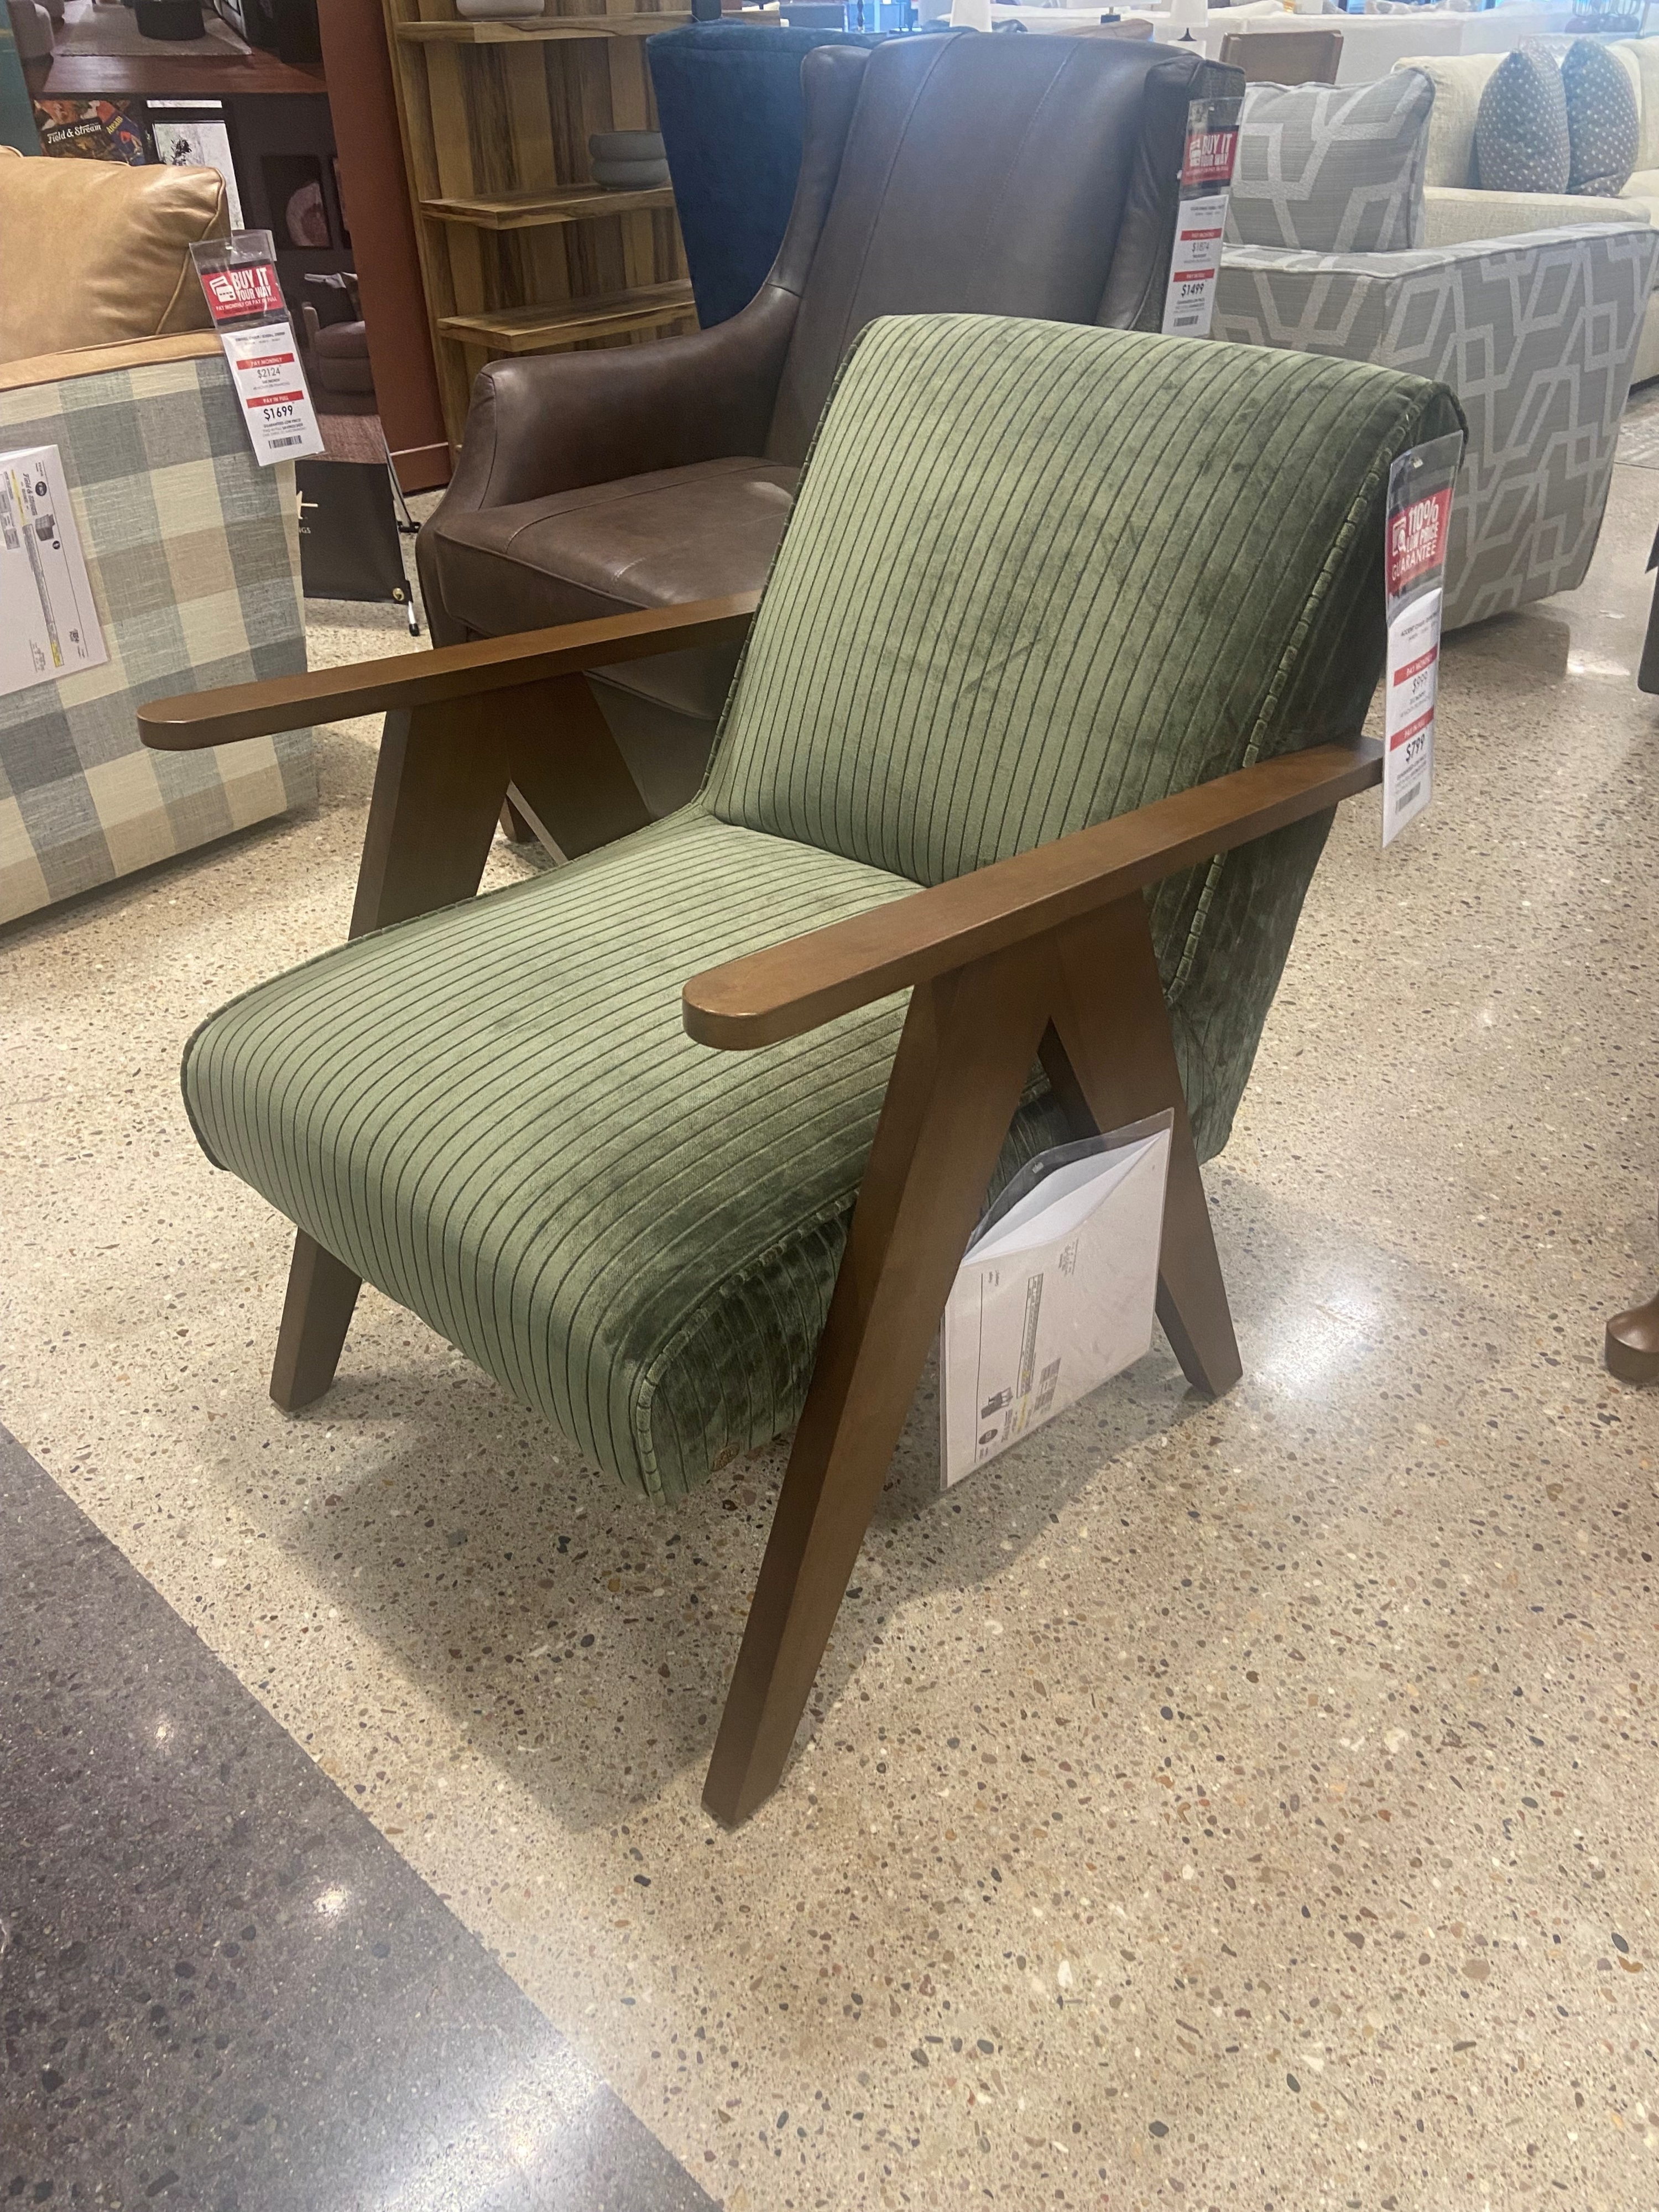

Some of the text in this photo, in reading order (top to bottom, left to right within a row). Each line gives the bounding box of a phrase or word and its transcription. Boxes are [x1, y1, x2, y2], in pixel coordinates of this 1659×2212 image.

[47, 124, 102, 144] Field & Stream
[1202, 133, 1233, 154] BUY IT
[1214, 153, 1229, 165] WAY
[231, 267, 269, 291] BUY IT
[236, 285, 272, 302] YOUR WAY
[1181, 283, 1204, 298] $1499
[250, 359, 260, 368] PAY
[257, 367, 280, 379] $2124
[264, 405, 293, 421] $1699
[1408, 497, 1439, 536] 110%
[1392, 539, 1437, 581] GUARANTEE
[1406, 733, 1425, 764] $799
